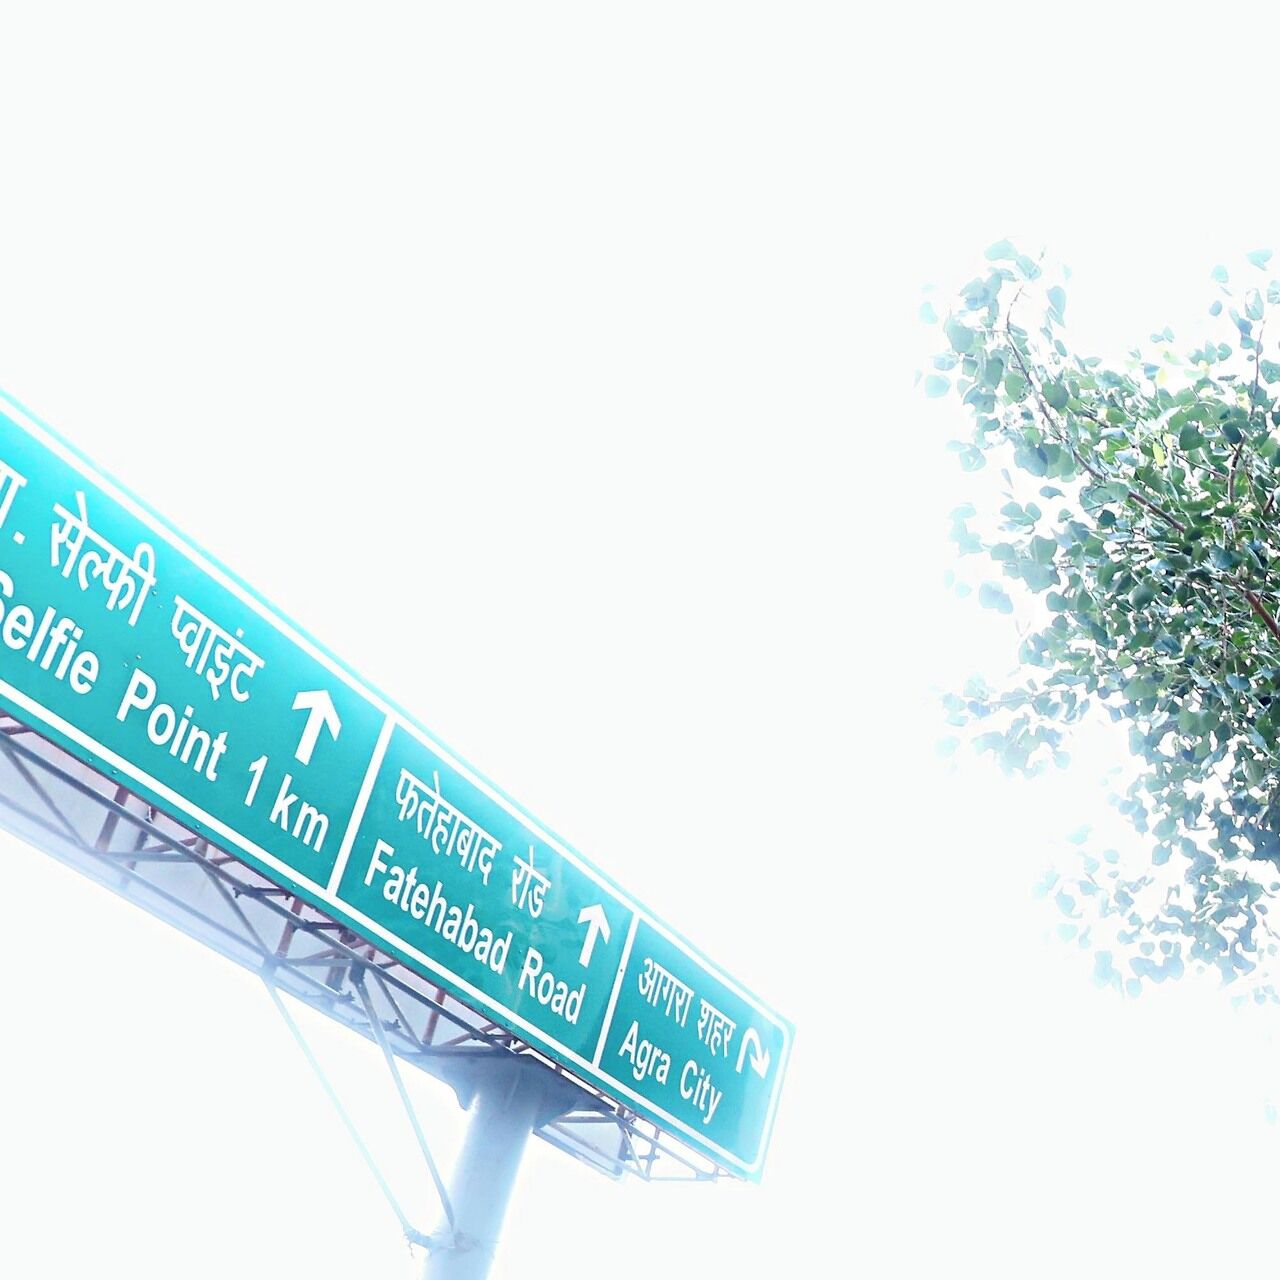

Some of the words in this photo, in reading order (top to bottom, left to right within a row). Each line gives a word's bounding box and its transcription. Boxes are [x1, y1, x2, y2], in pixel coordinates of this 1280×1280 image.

[51, 489, 157, 627] सेल्फी
[172, 594, 265, 703] प्वाइंट
[115, 668, 228, 784] Point
[247, 753, 268, 808] 1
[268, 772, 331, 853] km
[395, 766, 503, 886] फतेहाबाद
[510, 844, 552, 918] रोड
[363, 845, 513, 977] Fatehabad
[518, 944, 588, 1027] Road
[636, 955, 696, 1031] आगरा
[695, 996, 738, 1059] शहर
[616, 1019, 673, 1094] Agra
[678, 1056, 724, 1126] City
